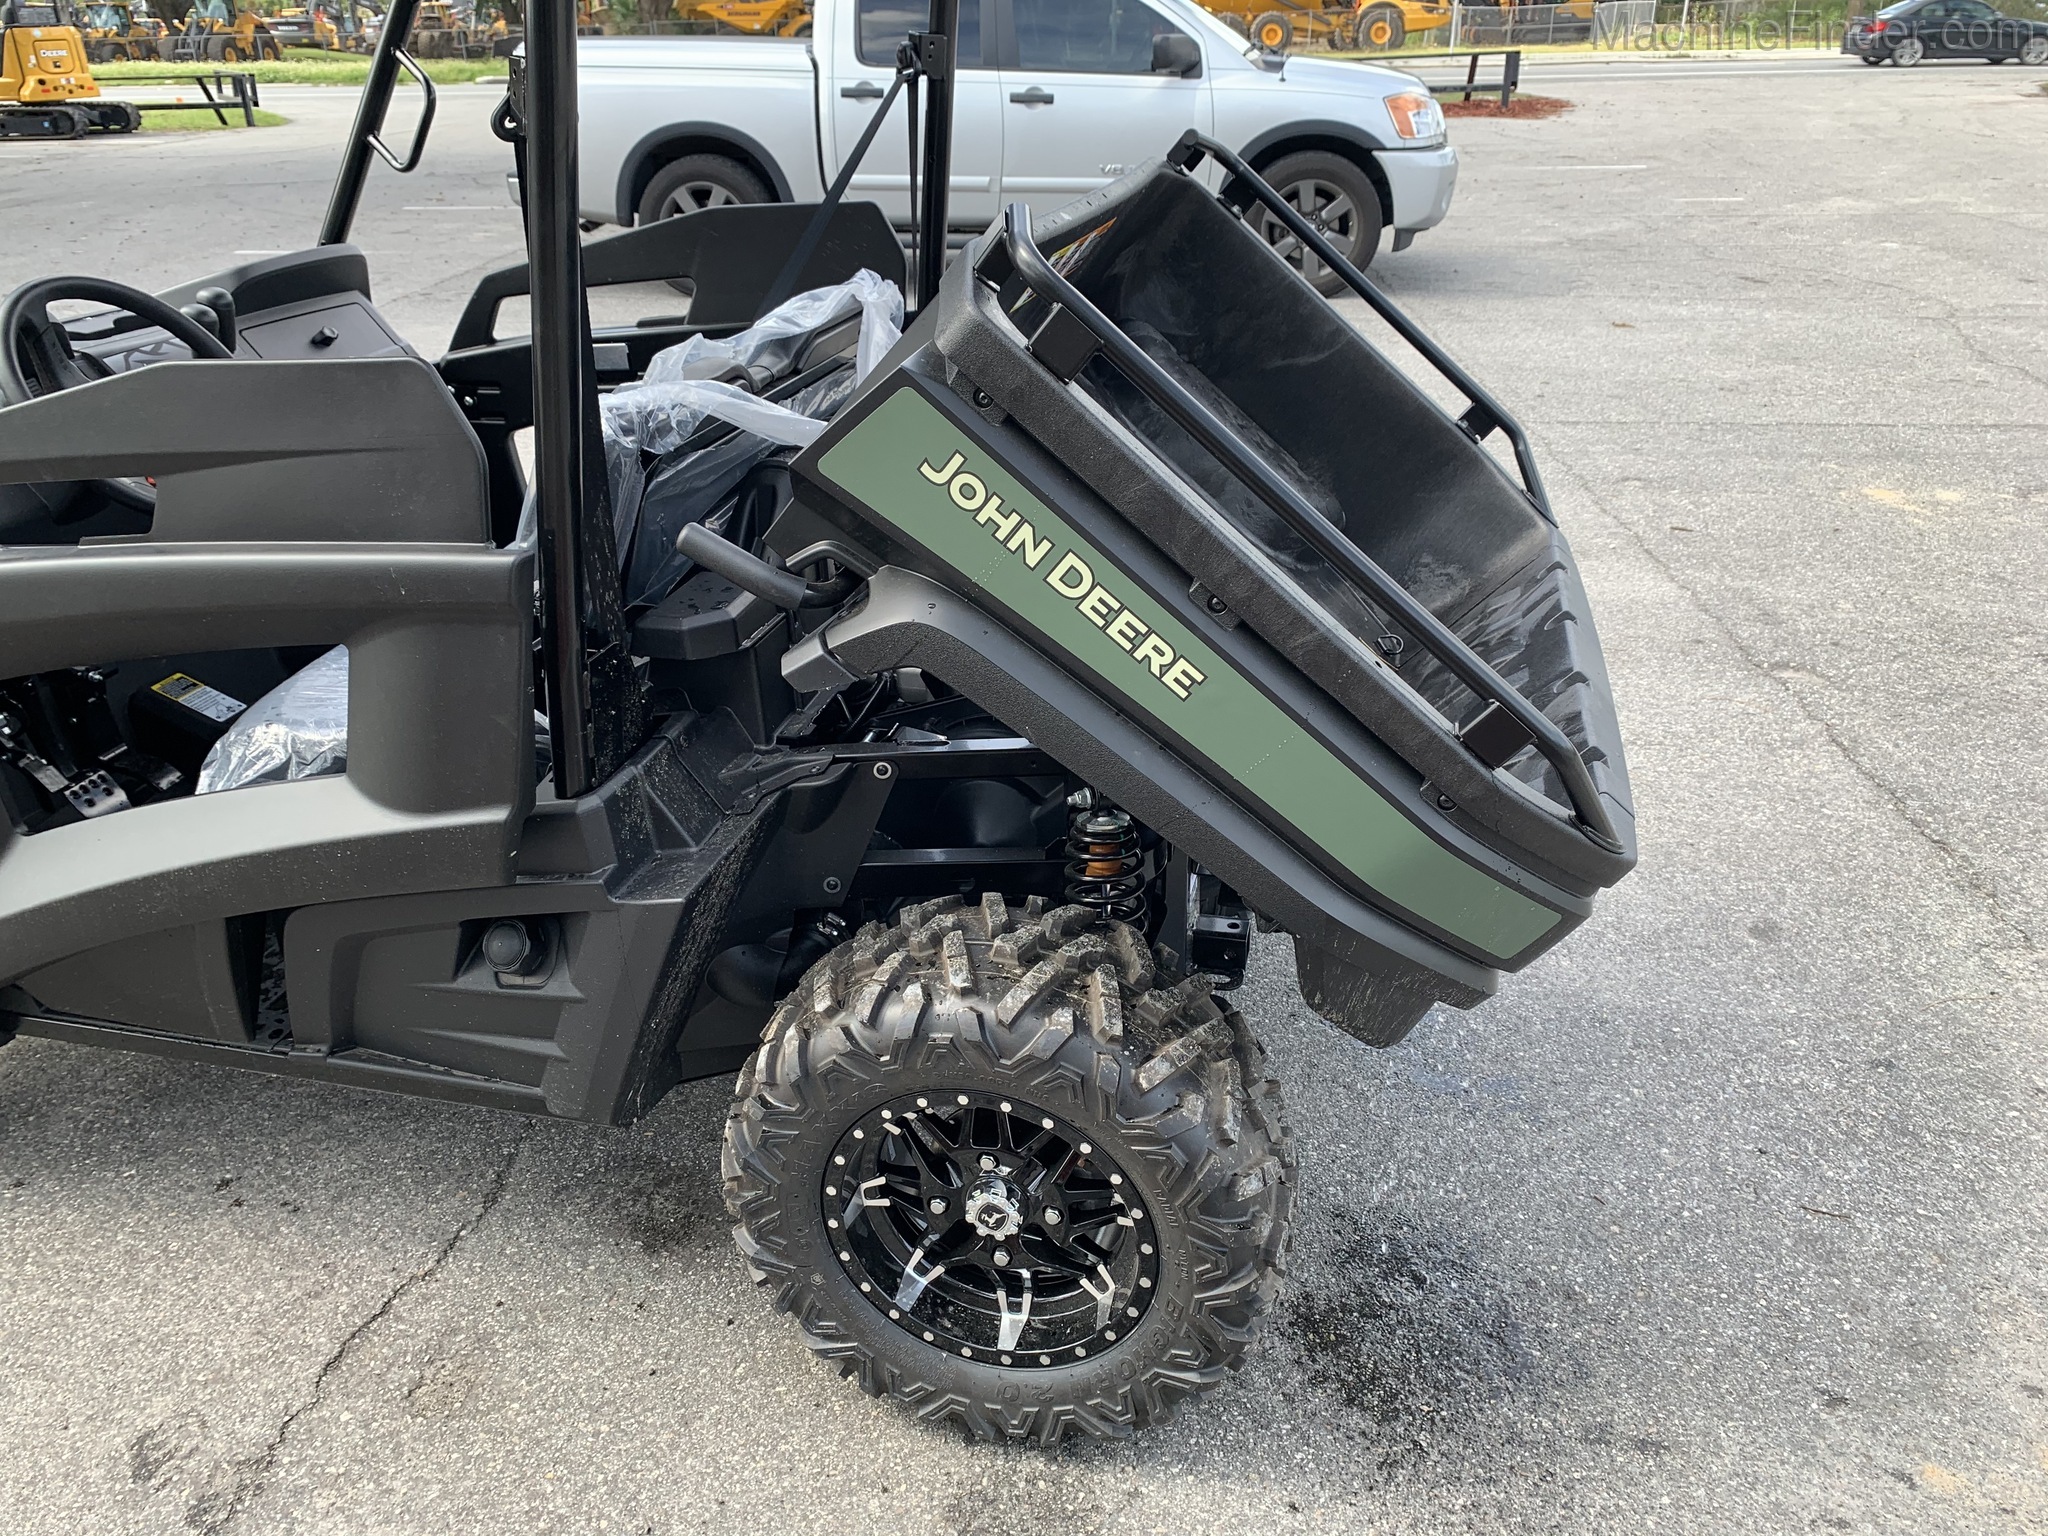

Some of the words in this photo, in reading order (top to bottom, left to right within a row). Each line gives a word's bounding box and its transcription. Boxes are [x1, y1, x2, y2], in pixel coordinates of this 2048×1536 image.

[40, 49, 68, 57] DEERE
[917, 449, 1055, 571] JOHN
[1043, 548, 1208, 702] DEERE
[1071, 1292, 1184, 1399] BIGHORN
[996, 1381, 1055, 1403] 2.0
